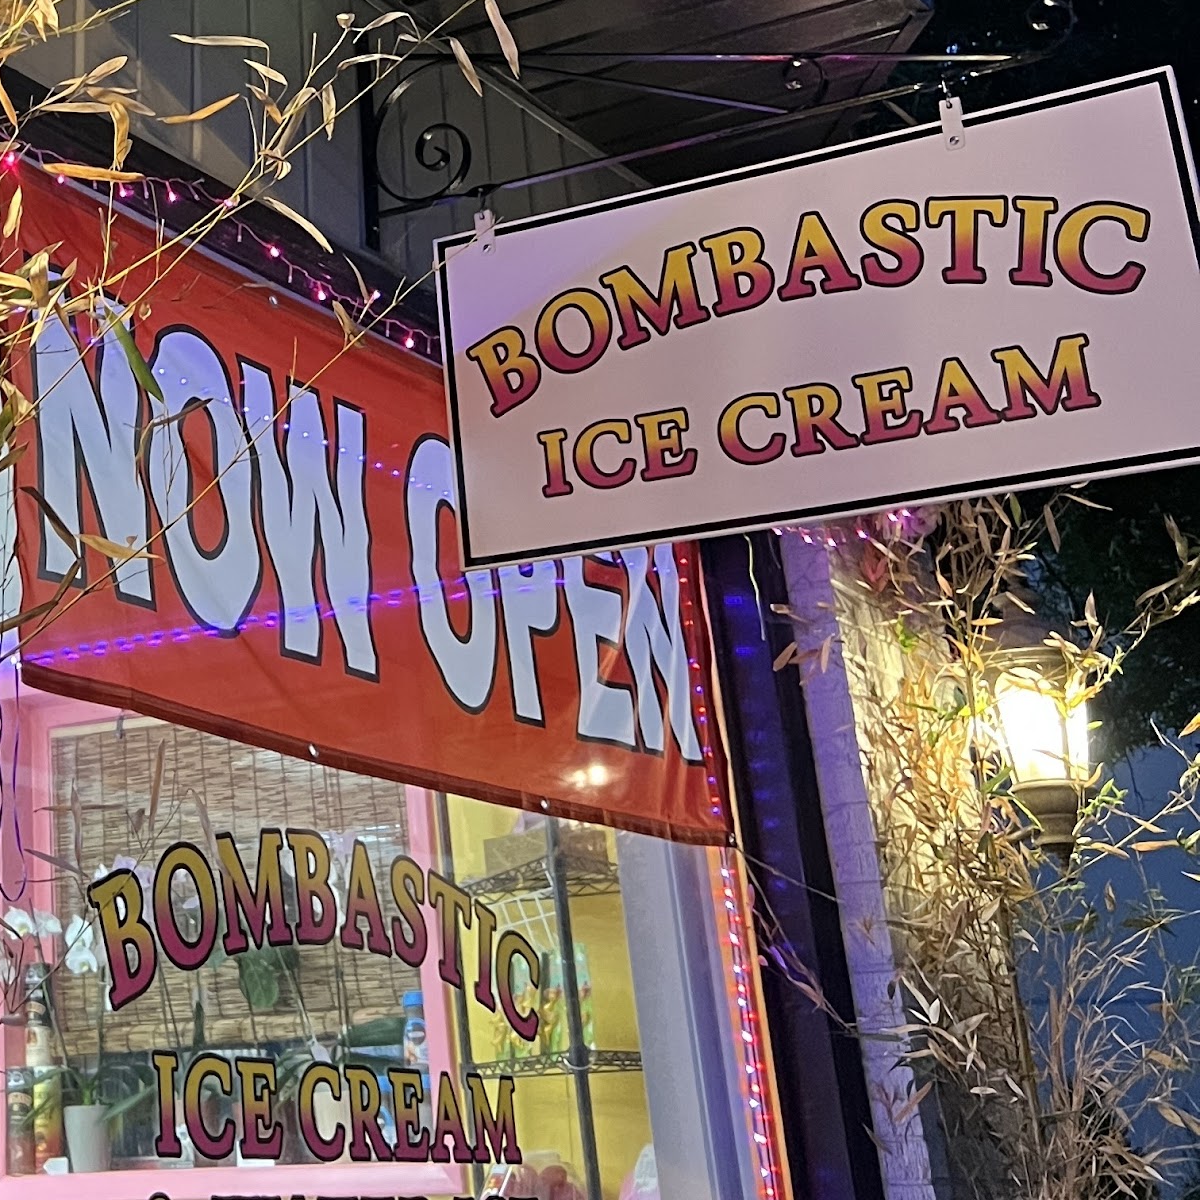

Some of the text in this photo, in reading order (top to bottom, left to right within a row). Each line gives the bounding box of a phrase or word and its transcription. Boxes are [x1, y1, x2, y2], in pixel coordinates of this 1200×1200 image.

[467, 196, 1150, 417] BOMBASTIC
[23, 250, 706, 767] NOW OPEN
[537, 333, 1101, 498] ICE CREAM
[88, 827, 541, 1042] BOMBASTIC
[152, 1049, 523, 1164] ICE CREAM
